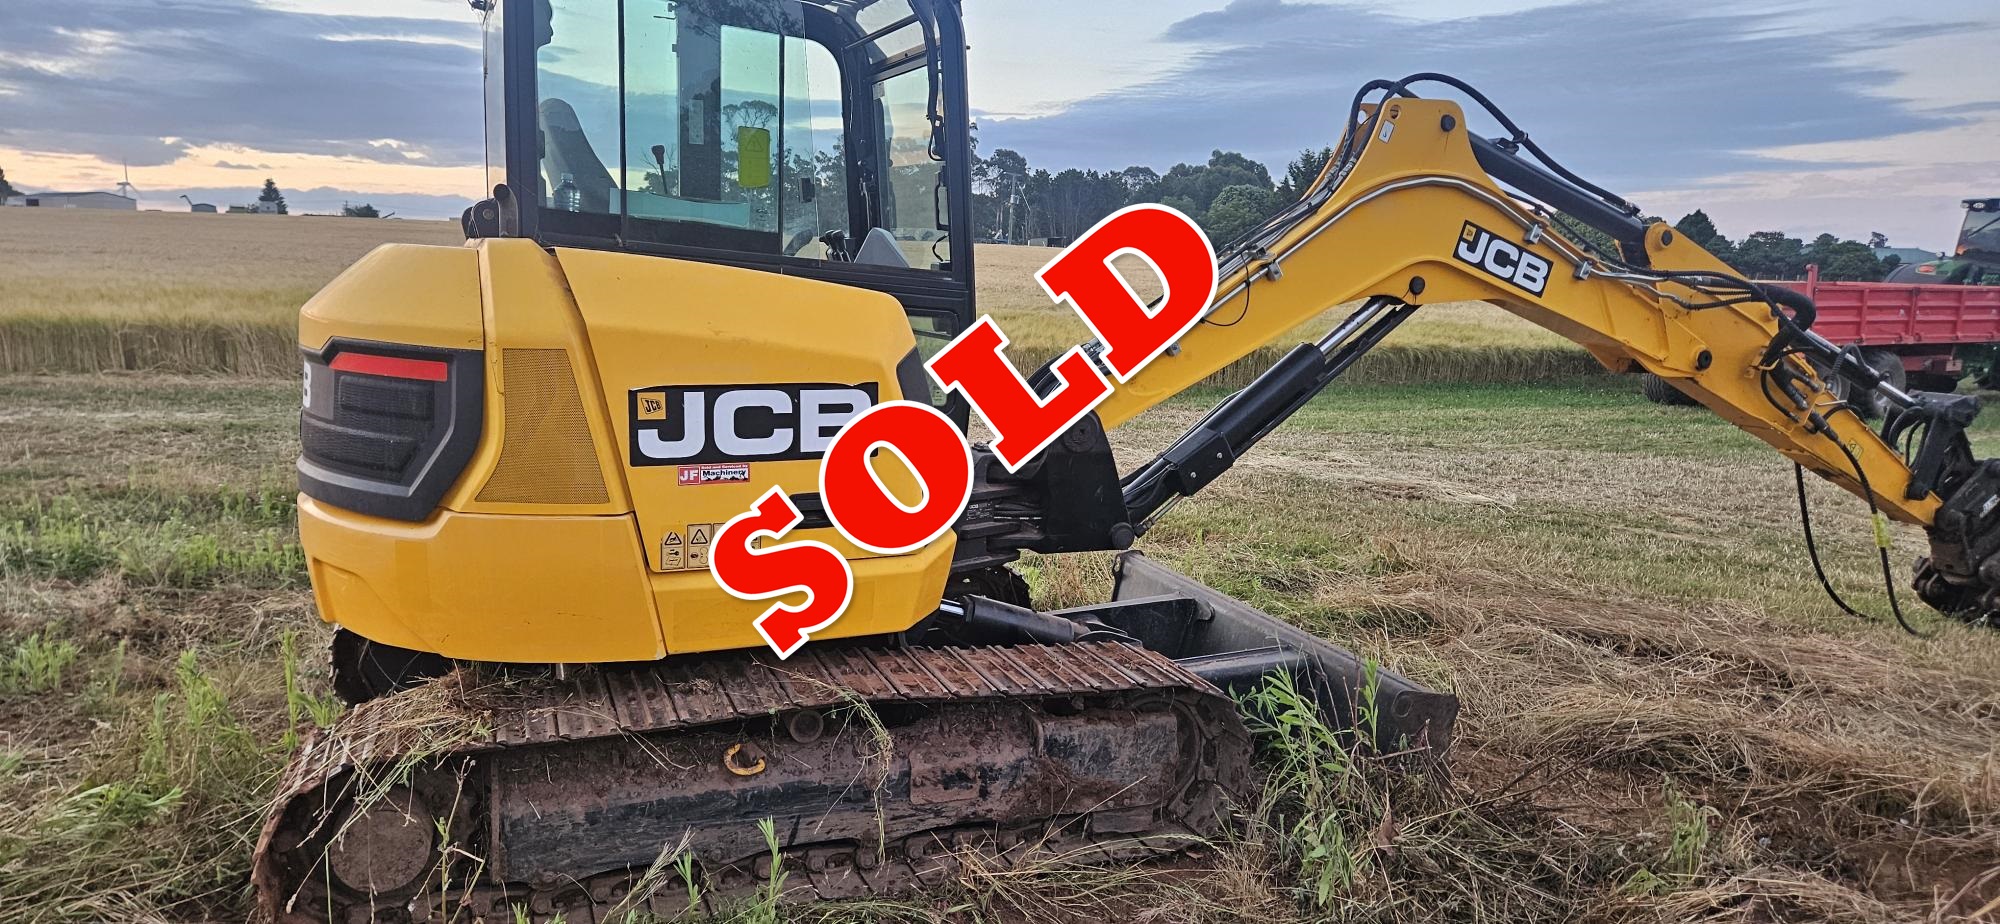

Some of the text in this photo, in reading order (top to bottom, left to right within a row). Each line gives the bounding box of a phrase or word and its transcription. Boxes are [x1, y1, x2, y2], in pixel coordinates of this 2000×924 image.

[1458, 232, 1548, 292] JCB
[645, 400, 662, 412] JCB
[638, 390, 872, 459] JCB
[680, 470, 698, 481] JF
